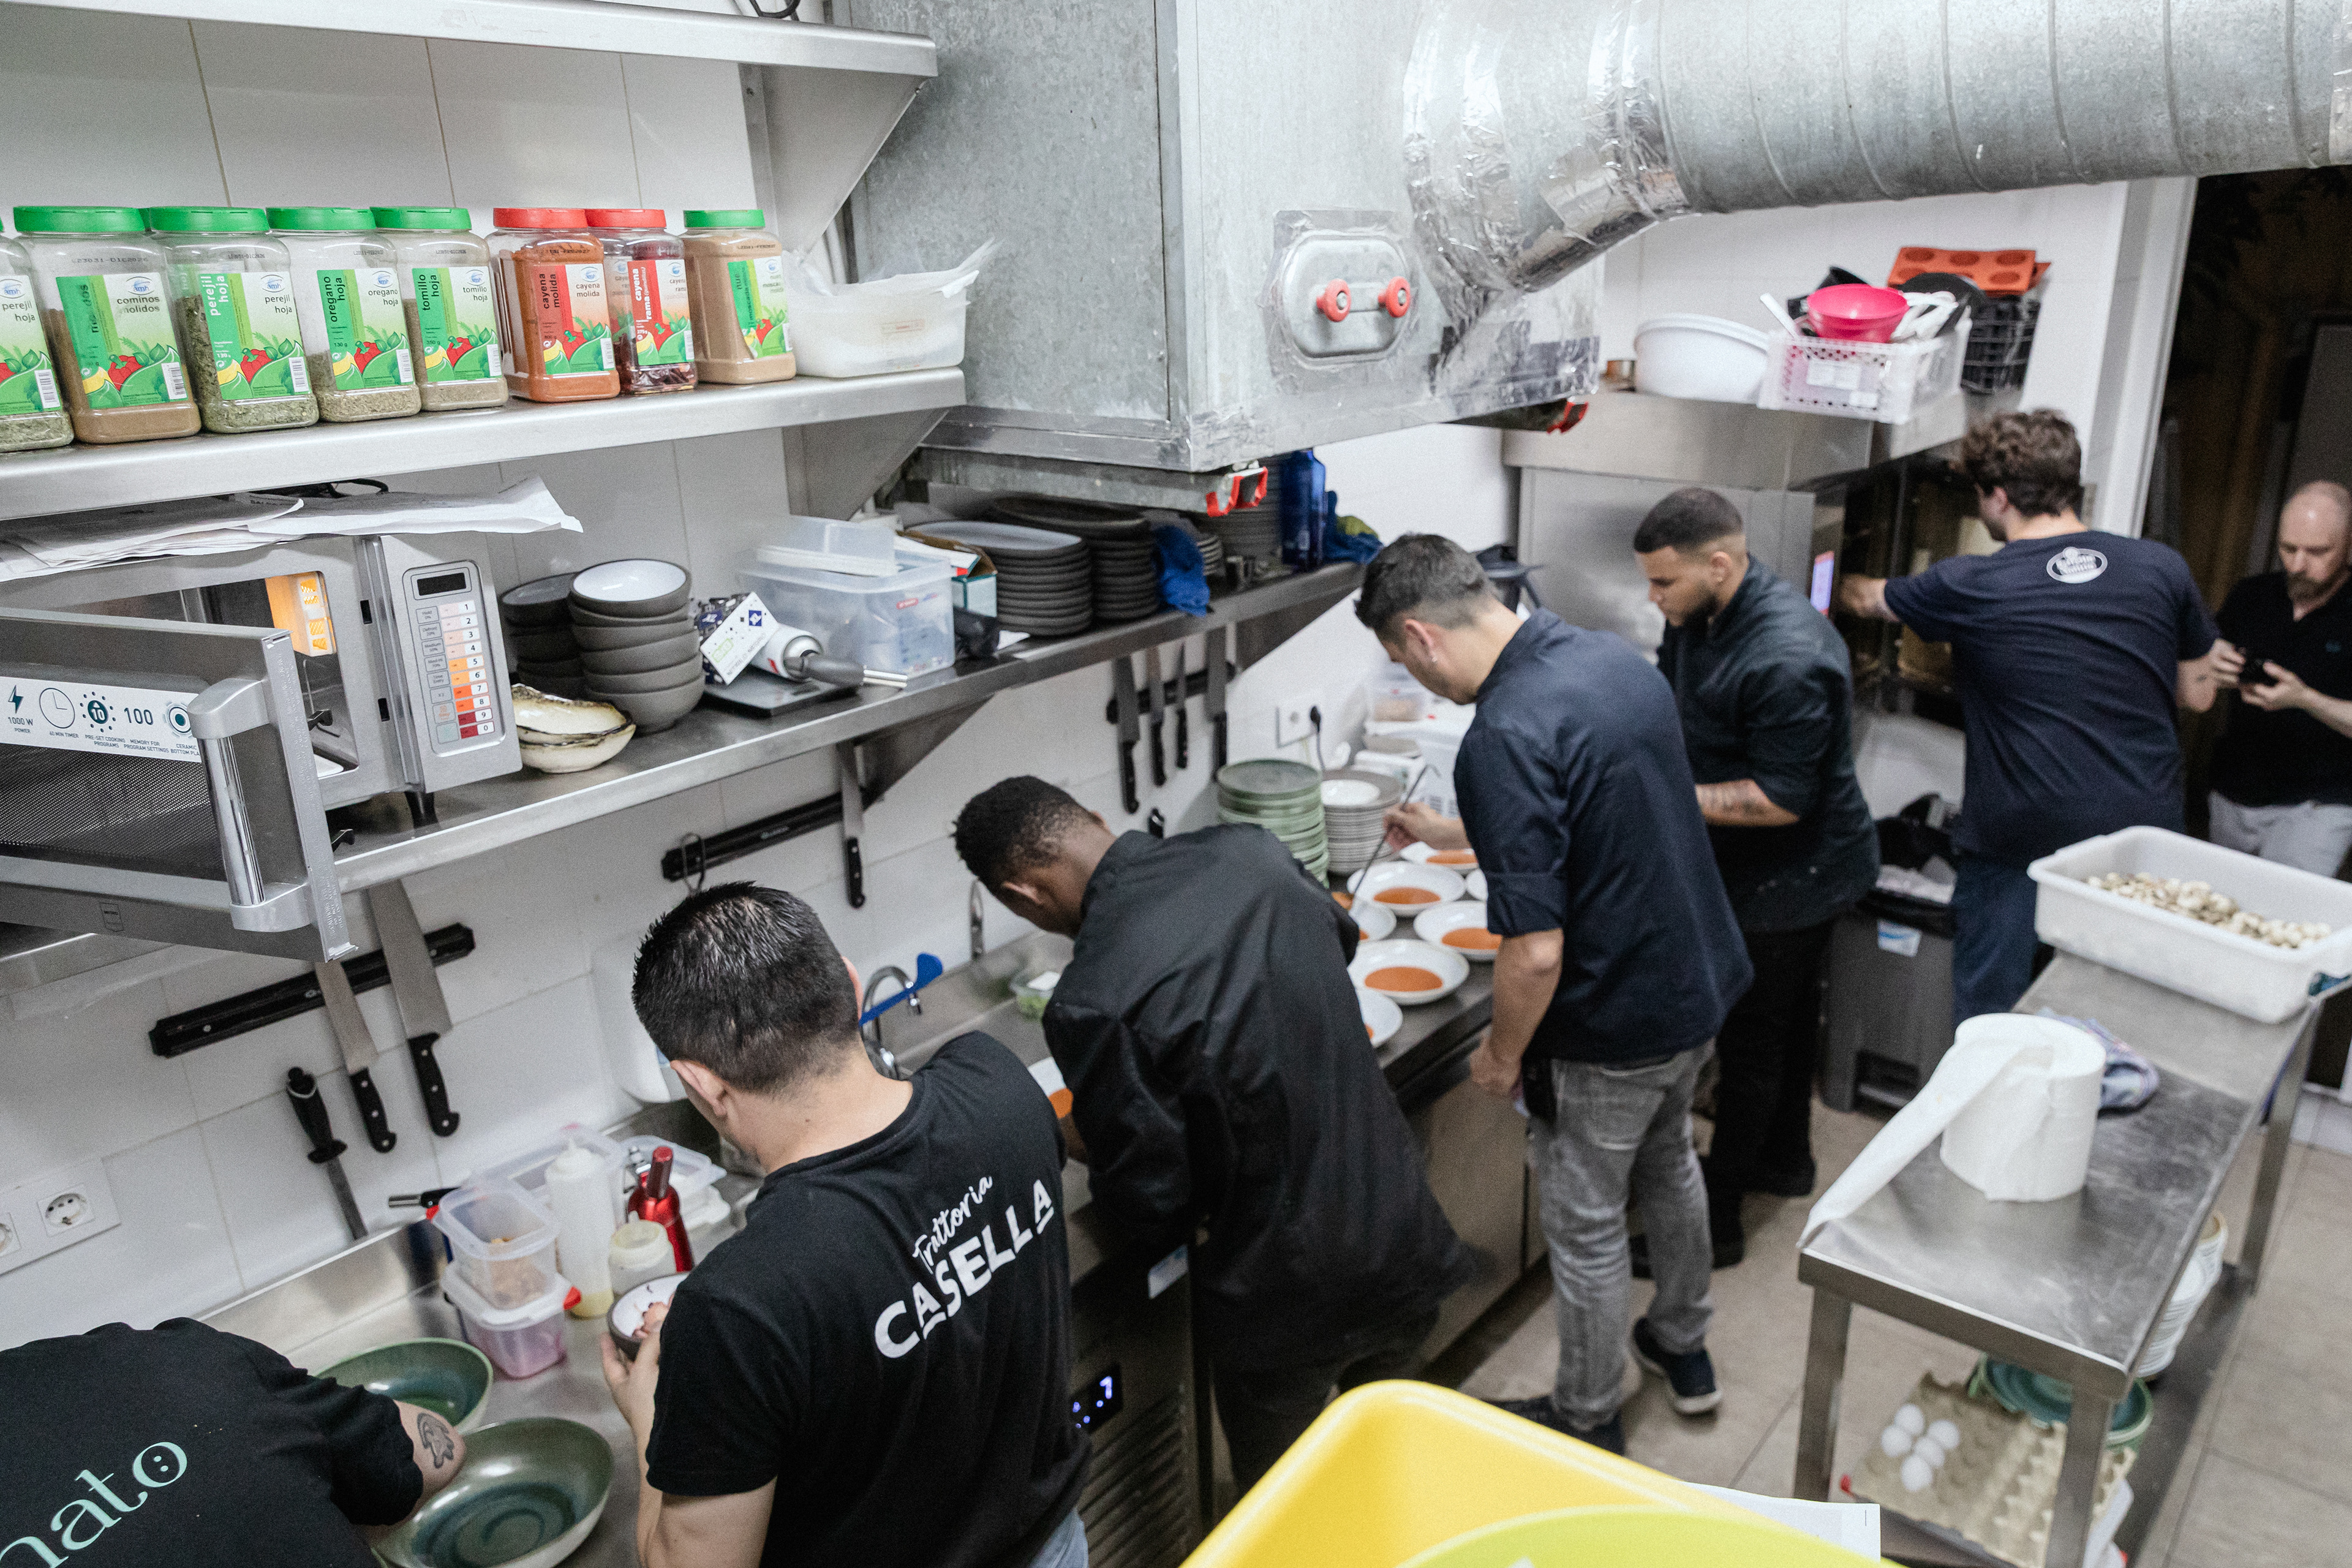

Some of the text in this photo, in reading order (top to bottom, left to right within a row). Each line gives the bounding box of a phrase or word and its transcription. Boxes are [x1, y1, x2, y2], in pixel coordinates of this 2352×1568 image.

[200, 276, 221, 316] perejil
[216, 276, 229, 303] hoja
[334, 277, 345, 301] hoja
[368, 288, 398, 298] oregano
[418, 274, 431, 311] tomillo
[429, 274, 440, 297] hoja
[539, 273, 550, 309] cayena
[550, 273, 560, 308] molida
[576, 282, 600, 291] cayena
[632, 268, 643, 301] cayena
[2, 300, 32, 312] perejil
[116, 295, 160, 304] cominos
[265, 294, 291, 304] perejil
[274, 306, 293, 315] hoja
[323, 276, 338, 322] oregano
[383, 298, 399, 307] hoja
[644, 296, 652, 320] rama
[15, 313, 36, 323] hoja
[8, 716, 24, 726] 1000
[91, 708, 105, 720] 10
[124, 707, 154, 725] 100
[911, 1175, 993, 1275] Trattoria
[874, 1179, 1054, 1359] CASELLA
